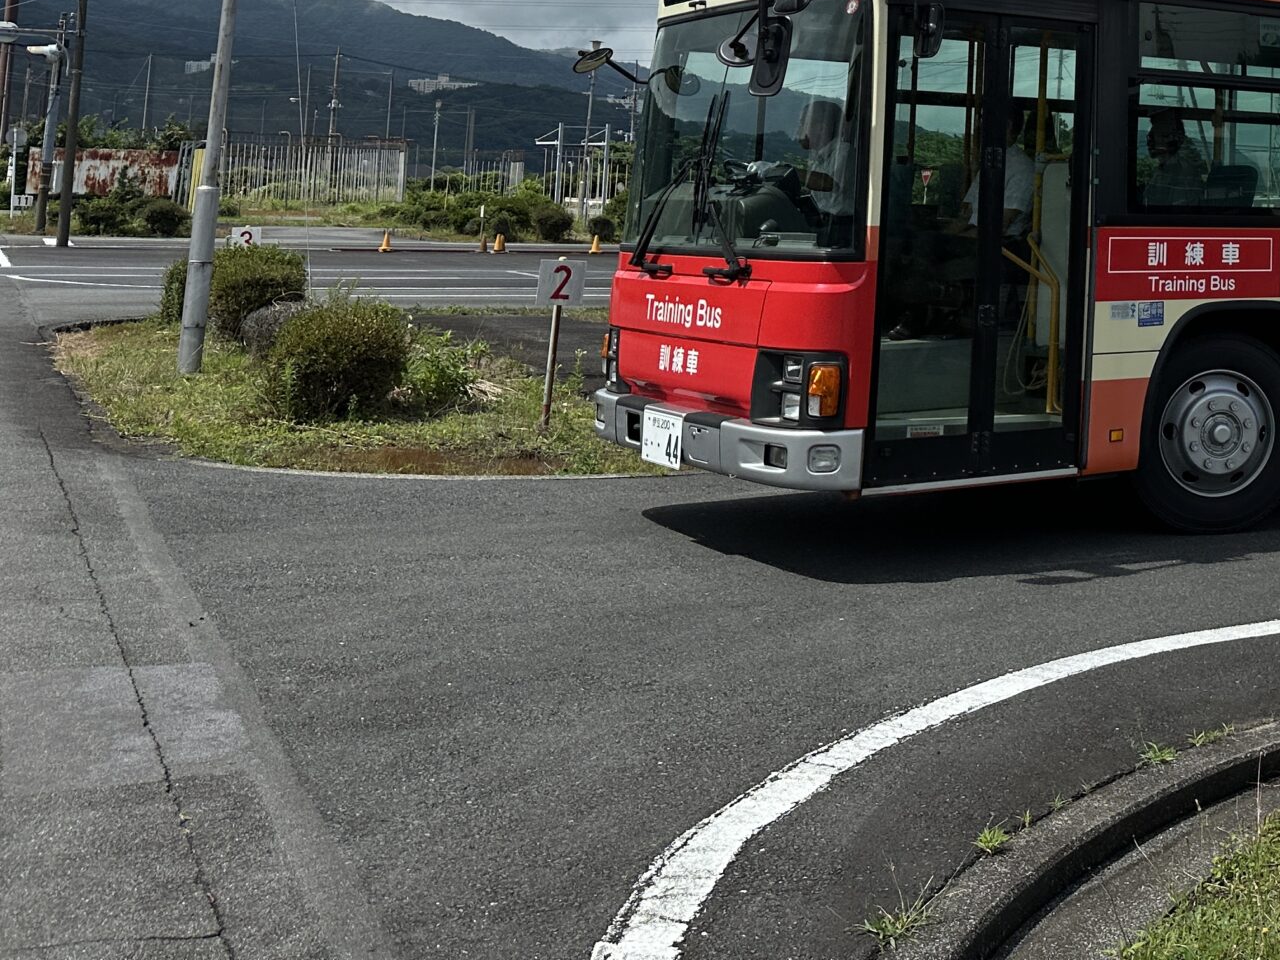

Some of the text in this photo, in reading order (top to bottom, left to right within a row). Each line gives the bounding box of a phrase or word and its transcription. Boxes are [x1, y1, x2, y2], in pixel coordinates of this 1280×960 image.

[1148, 242, 1240, 266] 訓練車
[549, 263, 572, 300] 2
[1148, 276, 1236, 292] Training Bus
[645, 294, 722, 328] Training Bus
[658, 344, 699, 375] 訓練車
[665, 433, 679, 465] 44
